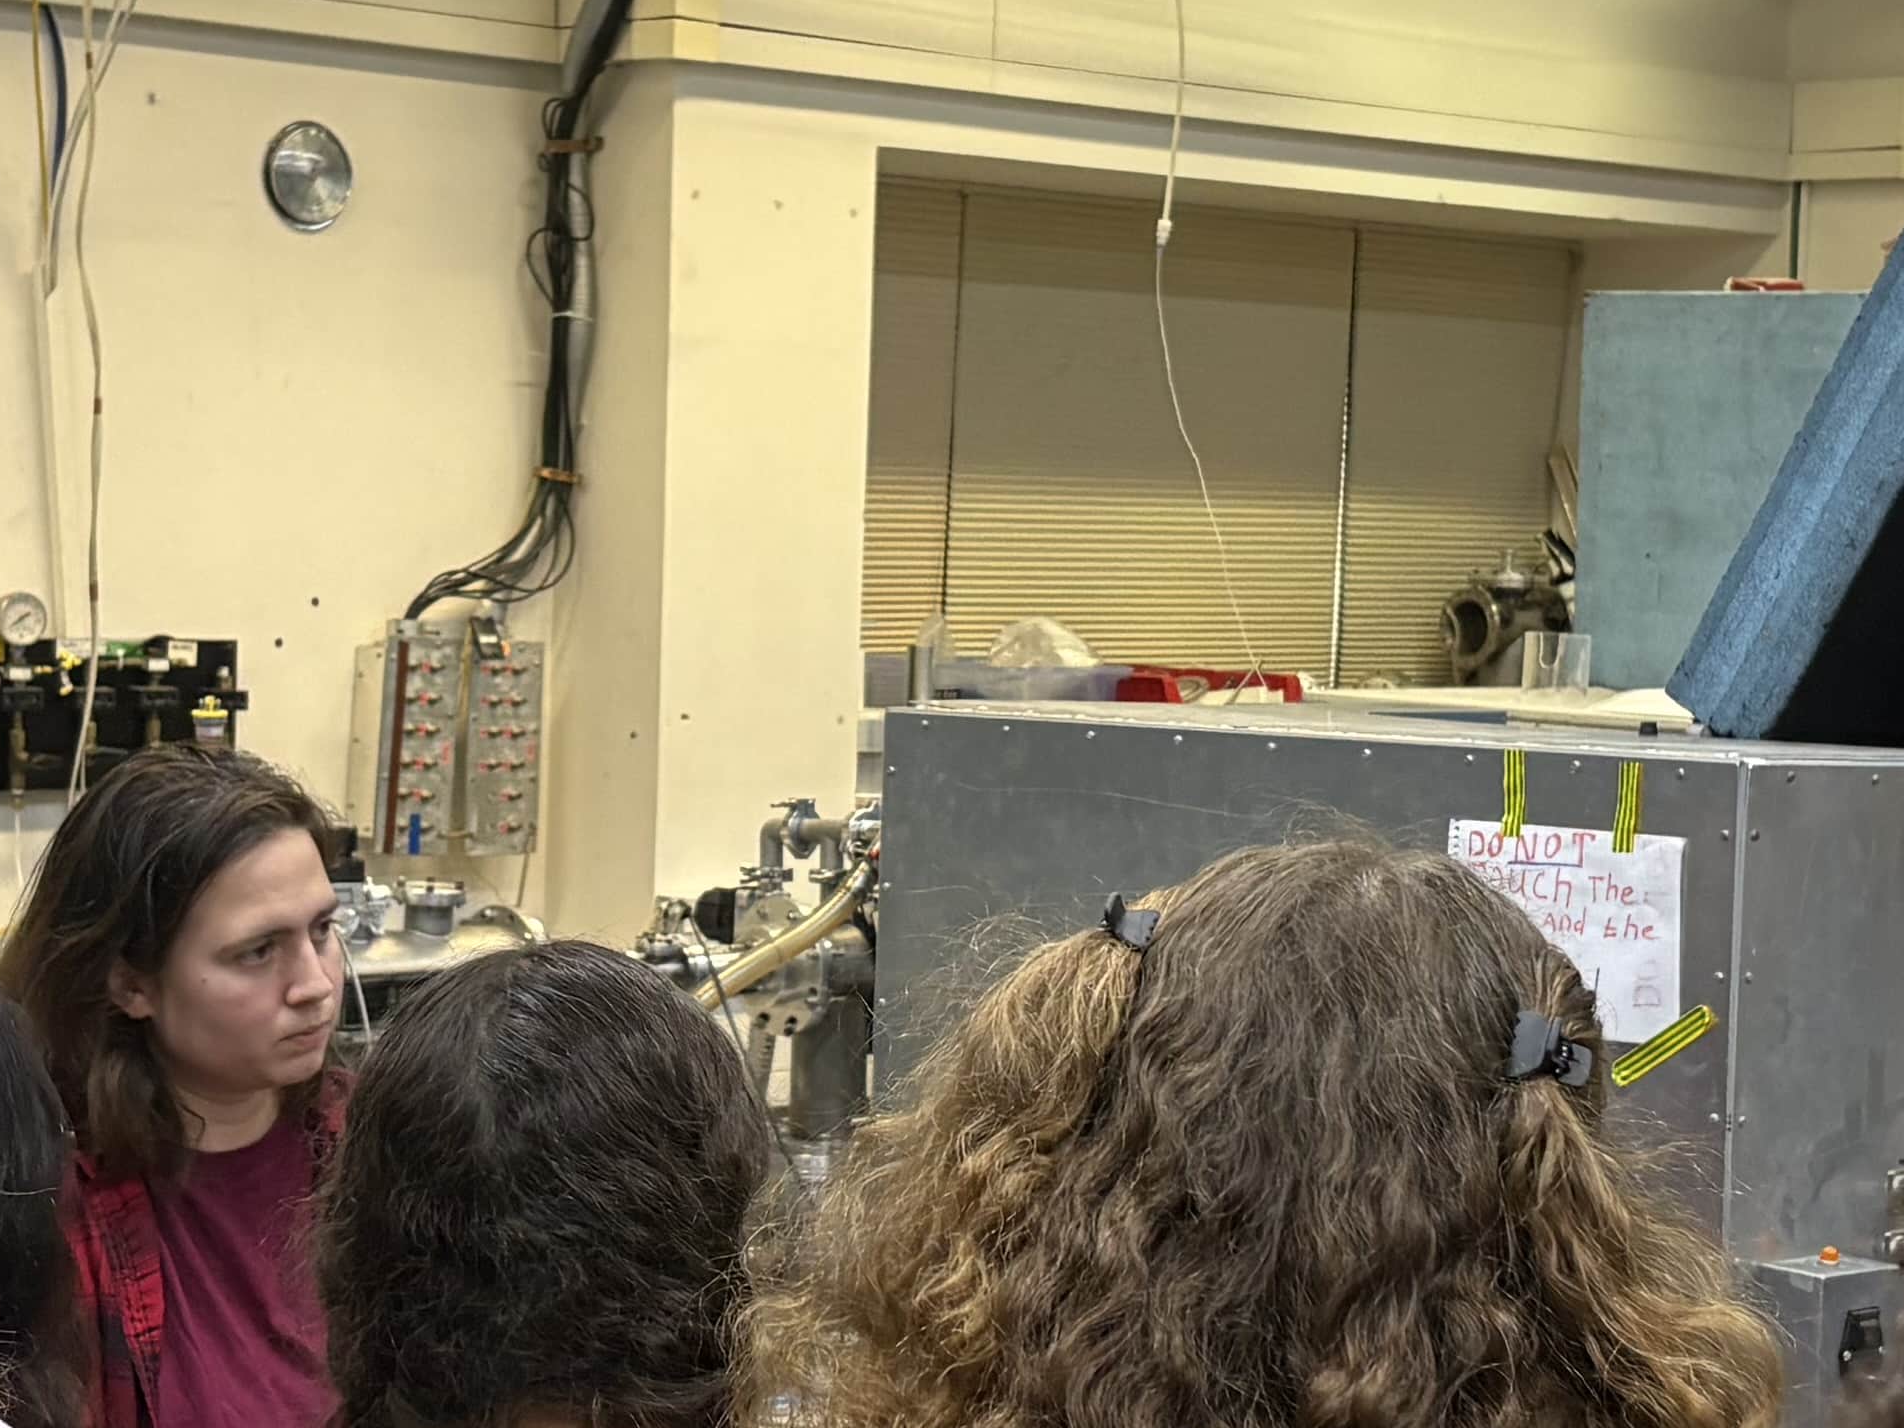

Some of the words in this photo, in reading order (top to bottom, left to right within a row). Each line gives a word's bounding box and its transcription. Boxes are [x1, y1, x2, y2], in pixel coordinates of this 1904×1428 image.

[1467, 829, 1504, 859] DO
[1514, 829, 1596, 867] NOT
[1603, 913, 1661, 941] the
